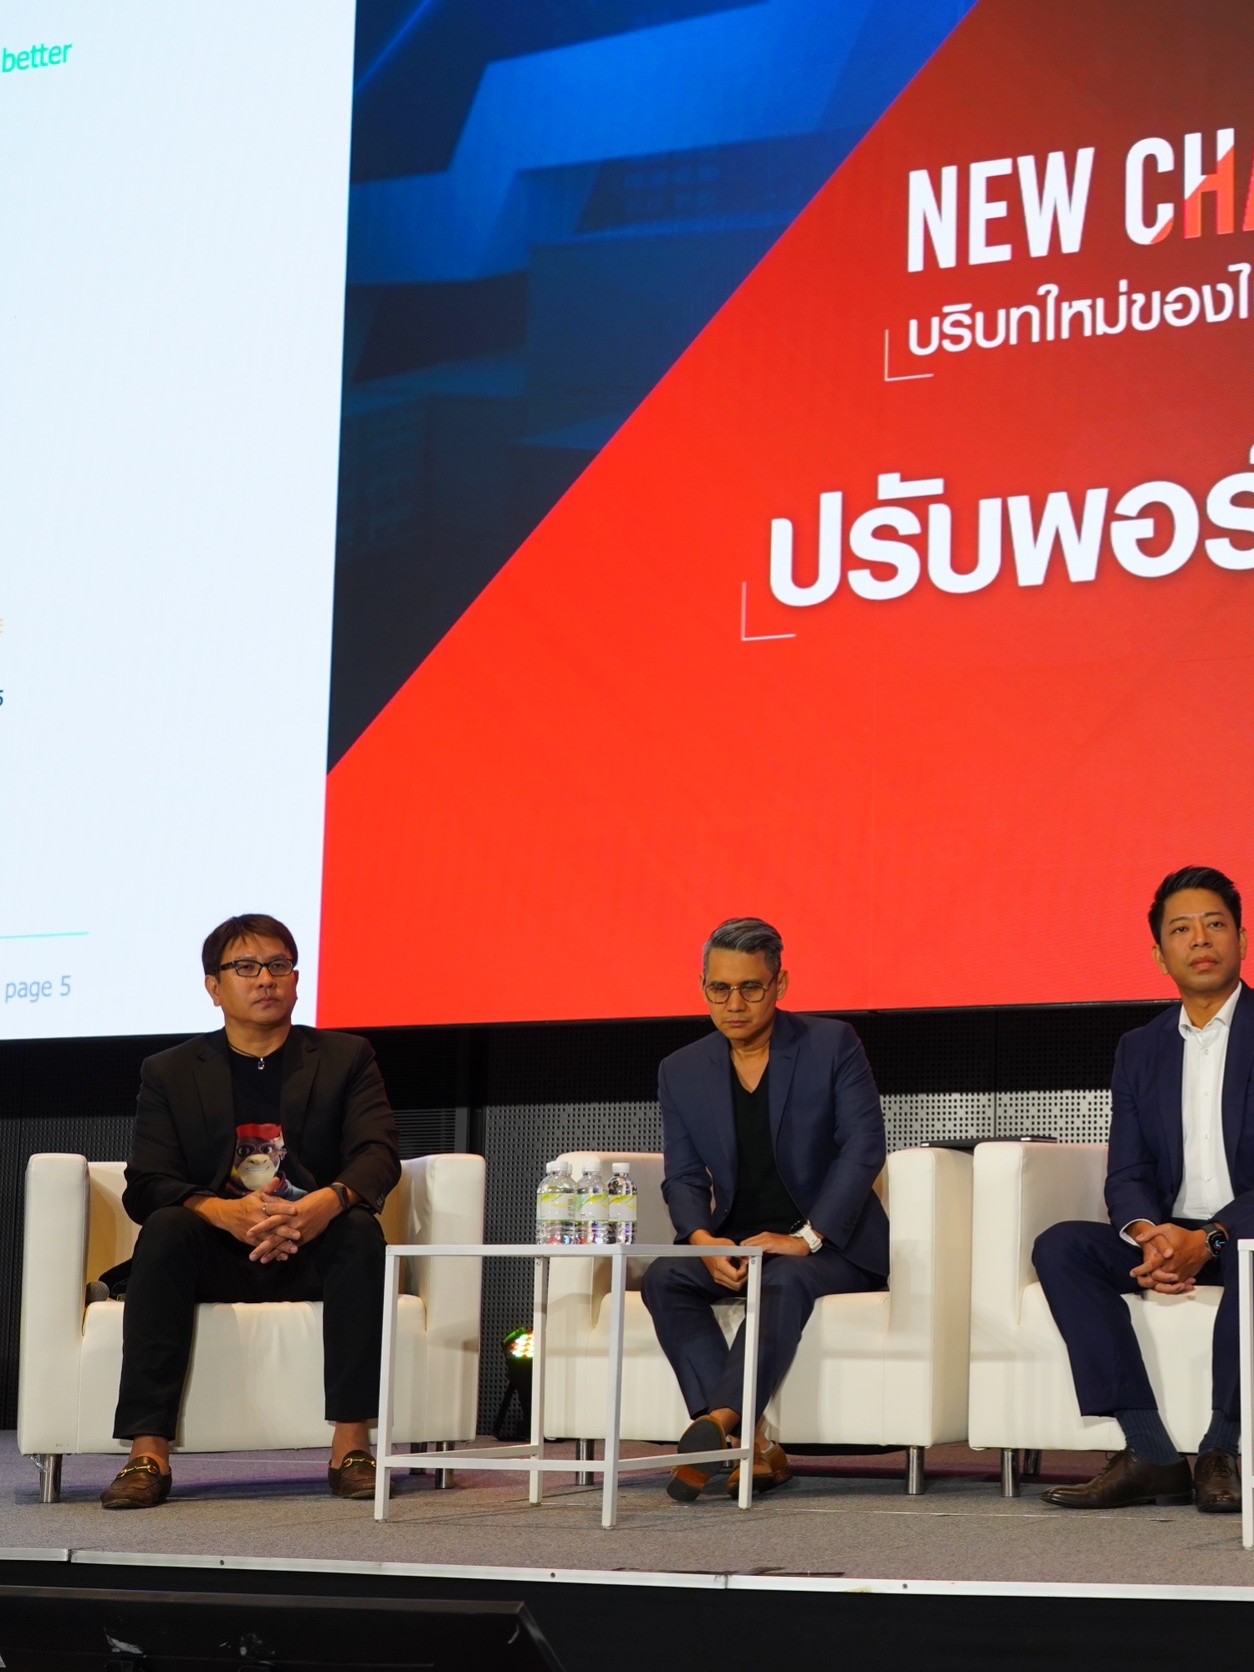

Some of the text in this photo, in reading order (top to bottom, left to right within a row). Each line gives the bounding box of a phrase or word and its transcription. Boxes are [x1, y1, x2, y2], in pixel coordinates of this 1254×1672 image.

[1, 43, 73, 73] better
[907, 146, 1095, 273] NEW
[5, 974, 72, 1004] page 5
